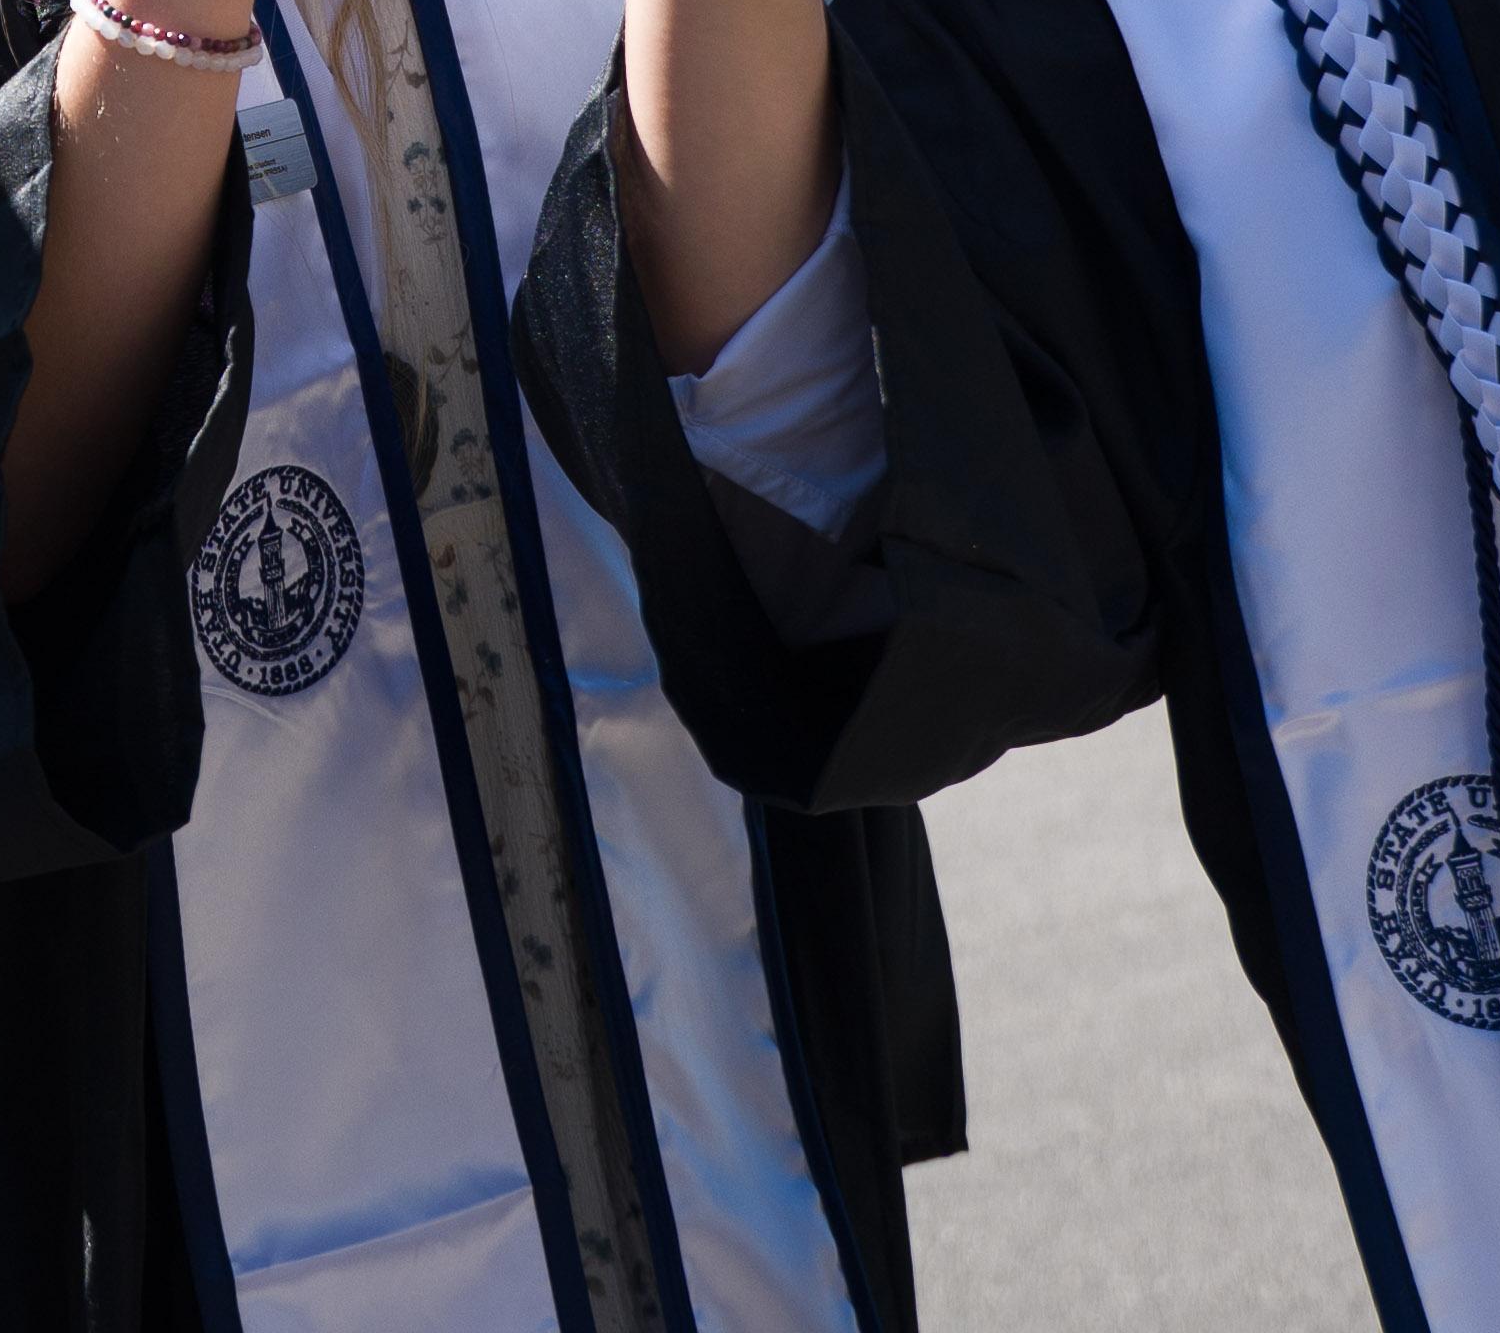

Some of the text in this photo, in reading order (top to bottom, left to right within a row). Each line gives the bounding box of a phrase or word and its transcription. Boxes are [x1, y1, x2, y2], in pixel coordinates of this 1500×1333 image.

[243, 129, 271, 142] tensen
[200, 475, 358, 673] UTAH STATE UNIVERSITY
[259, 654, 314, 684] 1888
[1375, 791, 1452, 891] STATE
[1379, 912, 1447, 1006] UTAH
